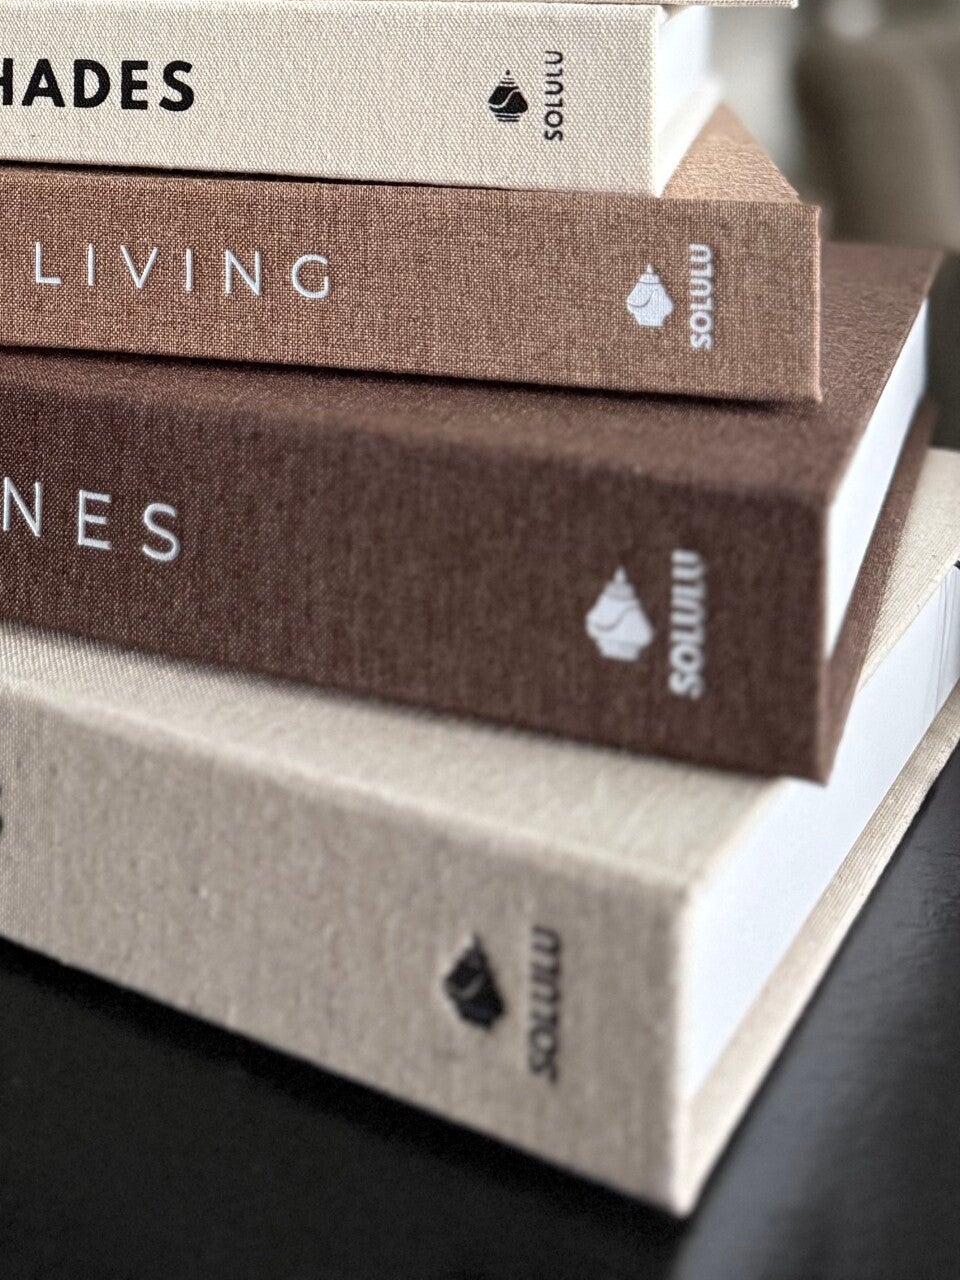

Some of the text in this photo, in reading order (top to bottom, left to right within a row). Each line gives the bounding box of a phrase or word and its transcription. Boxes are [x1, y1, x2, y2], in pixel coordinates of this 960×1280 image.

[543, 49, 565, 142] SOLULU
[34, 240, 331, 300] LIVING
[689, 242, 715, 351] SOLULU
[668, 549, 708, 701] SOLULU
[528, 925, 563, 1083] SOLULU
